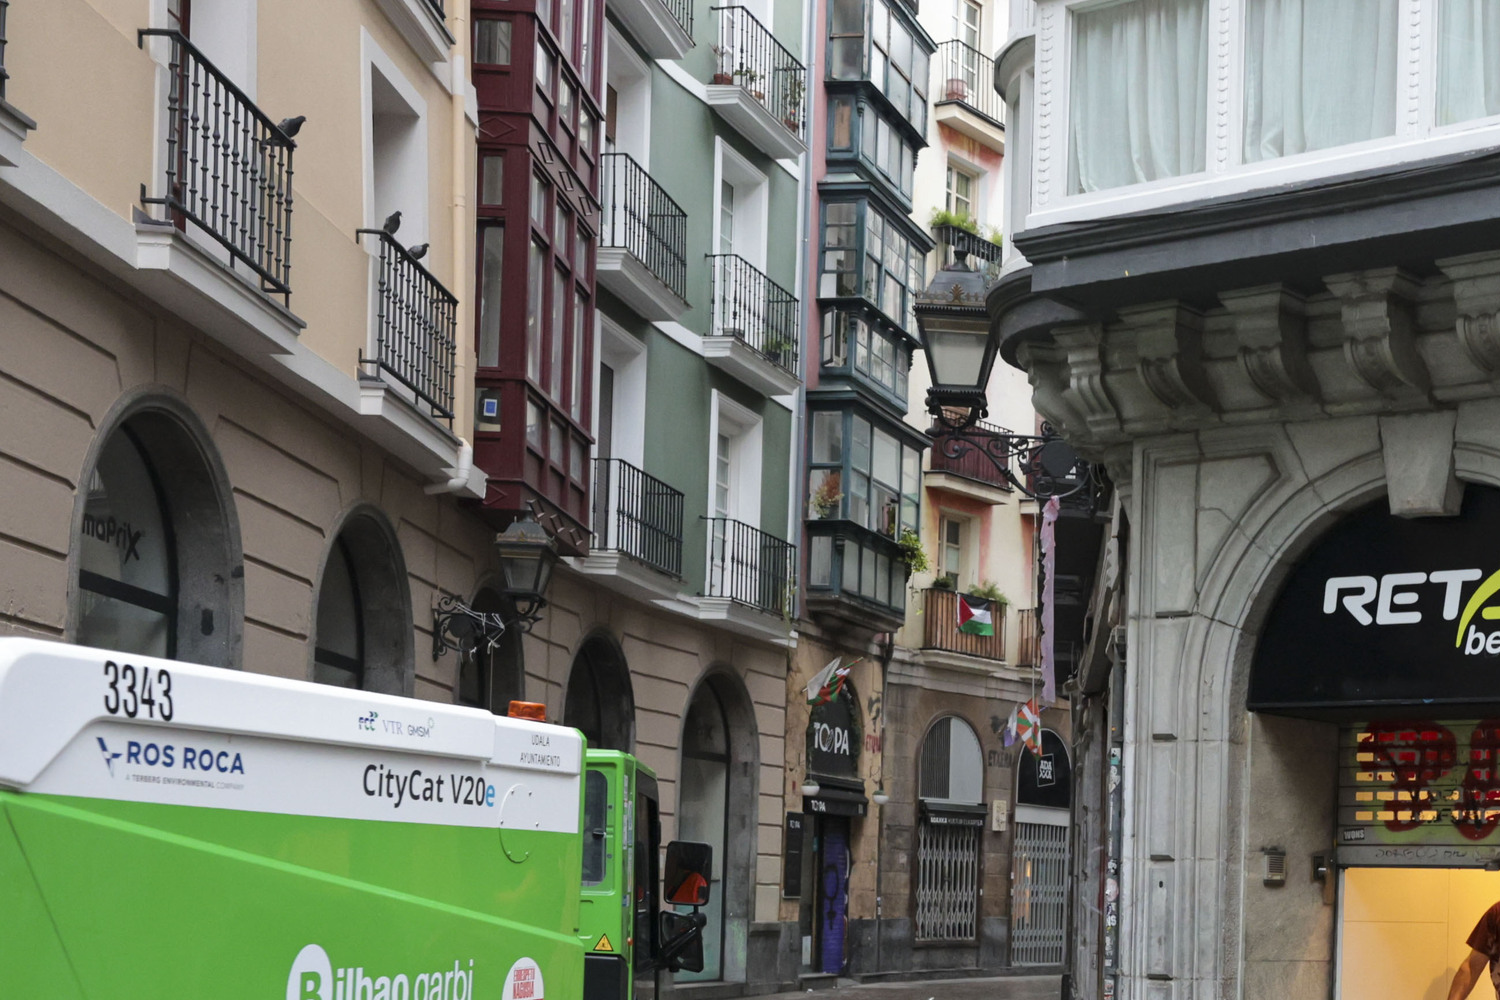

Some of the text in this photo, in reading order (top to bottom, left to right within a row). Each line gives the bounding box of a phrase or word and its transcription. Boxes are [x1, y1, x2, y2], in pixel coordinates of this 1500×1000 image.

[104, 660, 173, 722] 3343
[382, 720, 403, 736] VTR
[531, 735, 550, 747] UDALA
[127, 741, 245, 775] ROS ROCA
[520, 752, 561, 767] AYUNTAMIENTO
[363, 763, 496, 808] CityCat V20e
